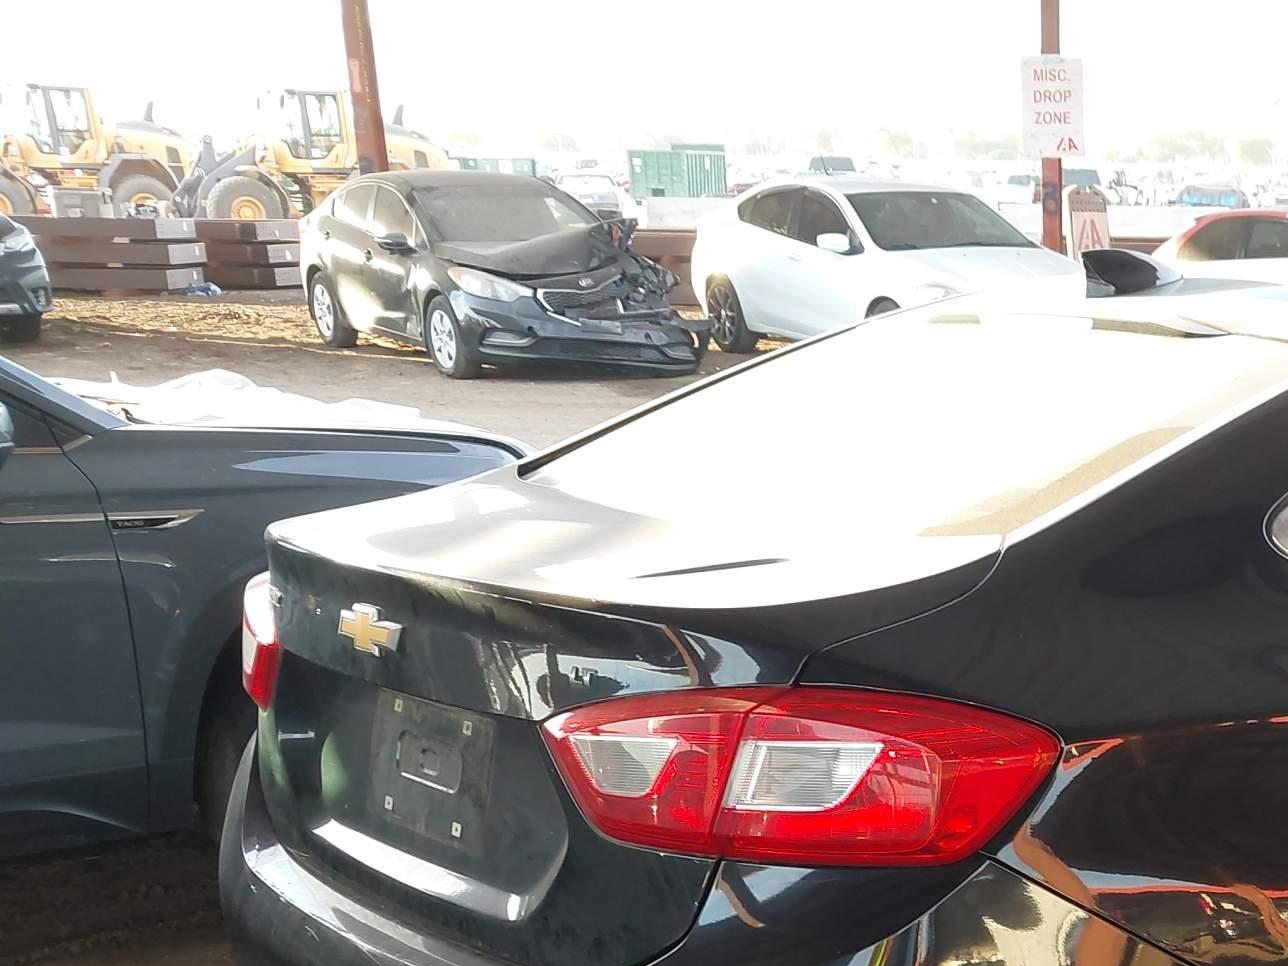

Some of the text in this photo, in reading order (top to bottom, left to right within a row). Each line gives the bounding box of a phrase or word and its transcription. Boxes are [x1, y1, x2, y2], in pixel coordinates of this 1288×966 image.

[1033, 68, 1071, 82] MISC.
[1033, 89, 1072, 104] DROP
[1034, 111, 1072, 125] ZONE
[569, 666, 598, 687] LT
